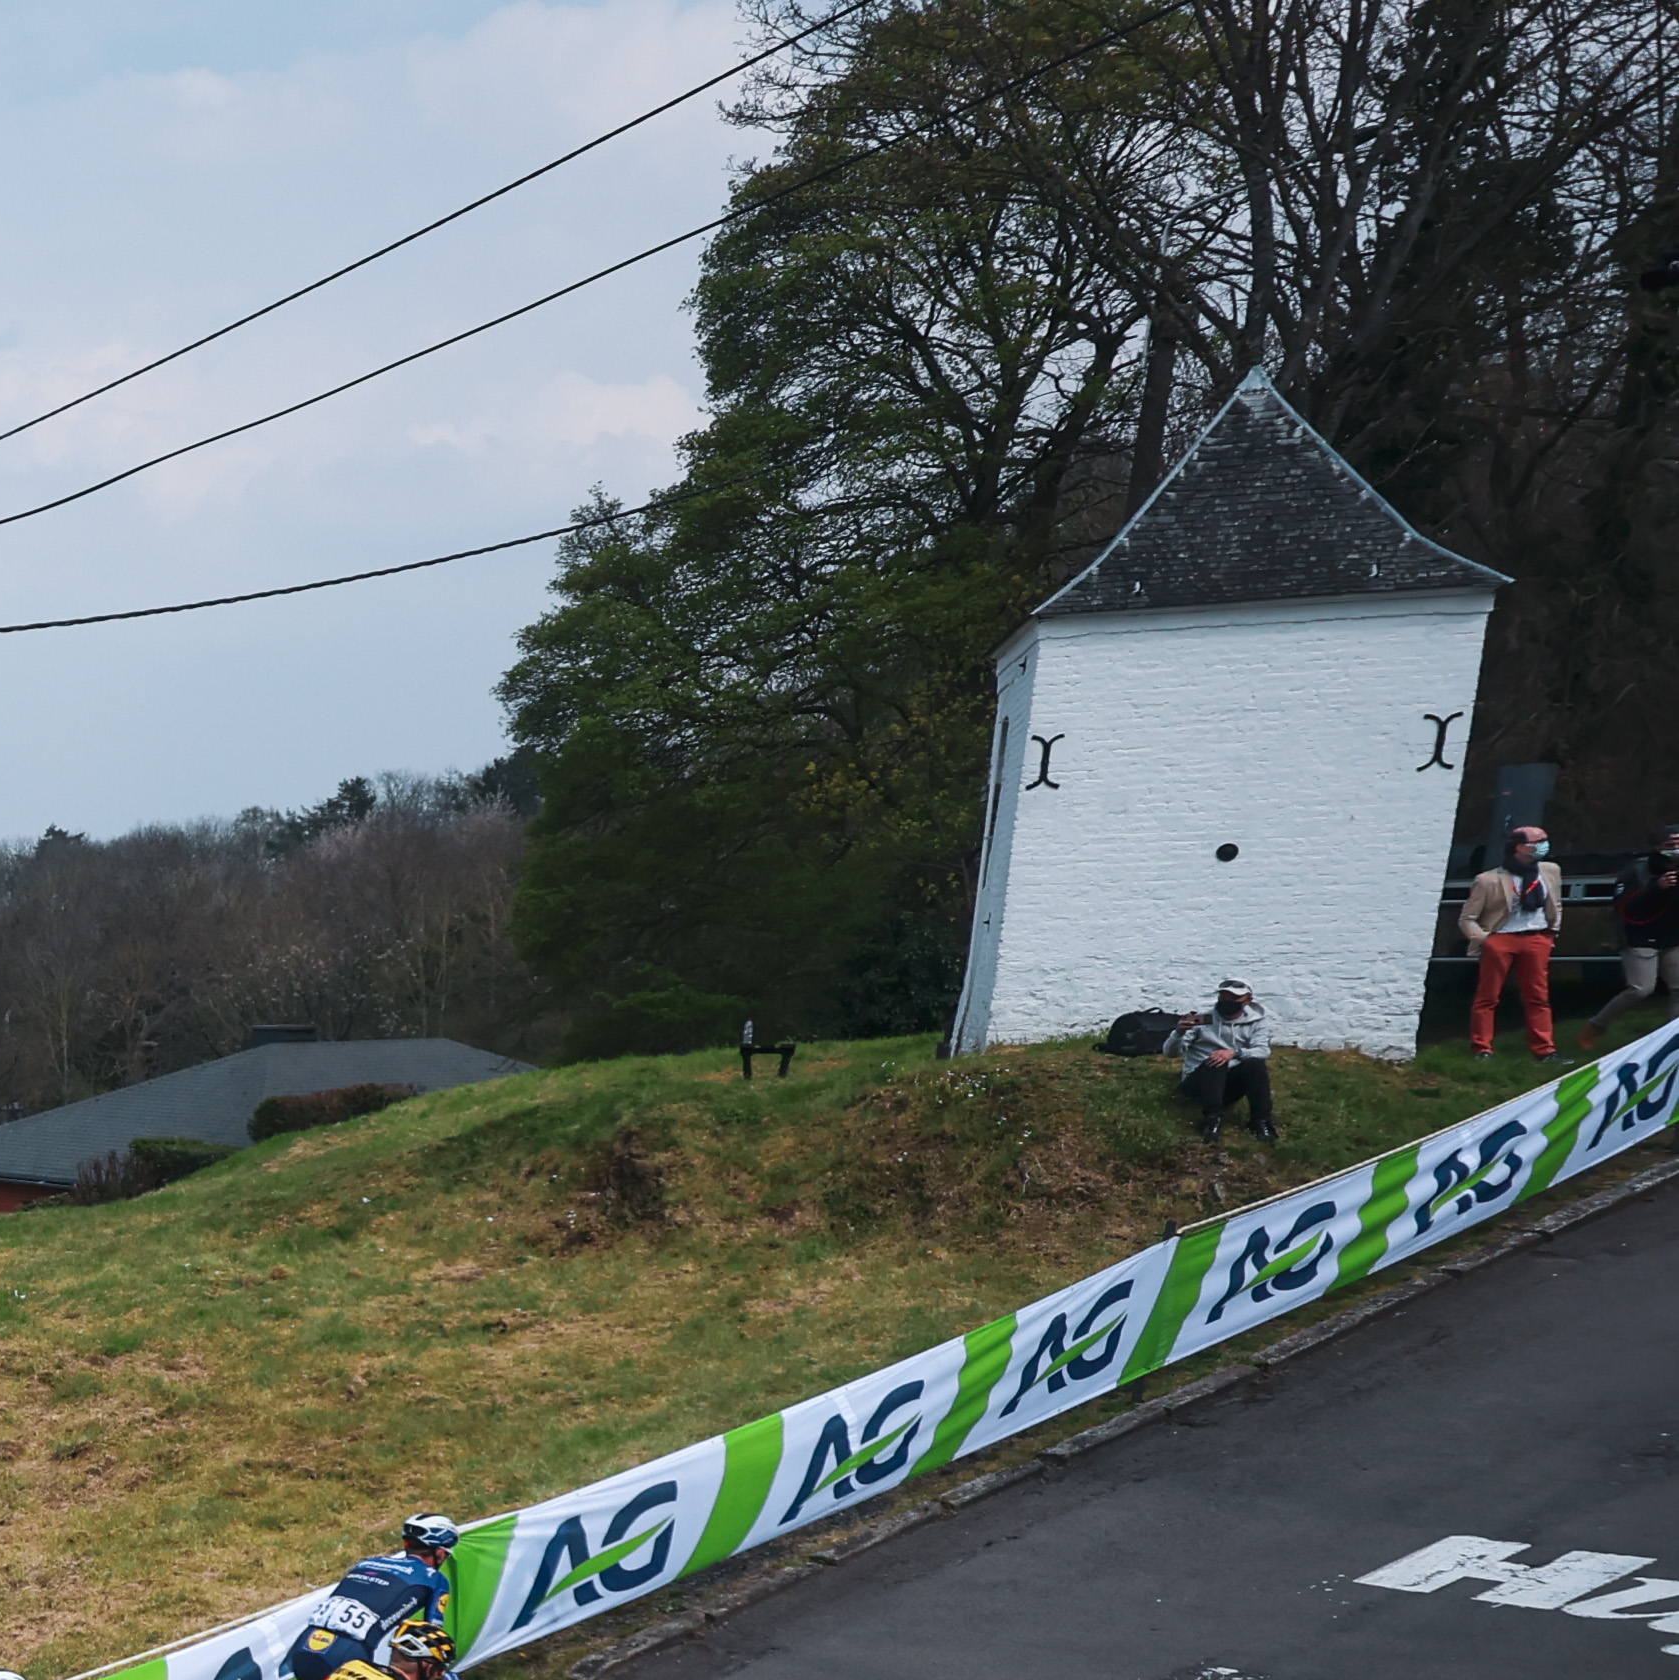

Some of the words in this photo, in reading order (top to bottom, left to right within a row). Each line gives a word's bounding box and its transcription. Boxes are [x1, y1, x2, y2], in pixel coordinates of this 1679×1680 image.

[1414, 1119, 1528, 1237] AG
[1205, 1201, 1339, 1324] AG
[999, 1279, 1134, 1418] AG
[780, 1380, 925, 1524] AG
[339, 1604, 371, 1630] 55
[511, 1480, 678, 1630] AG
